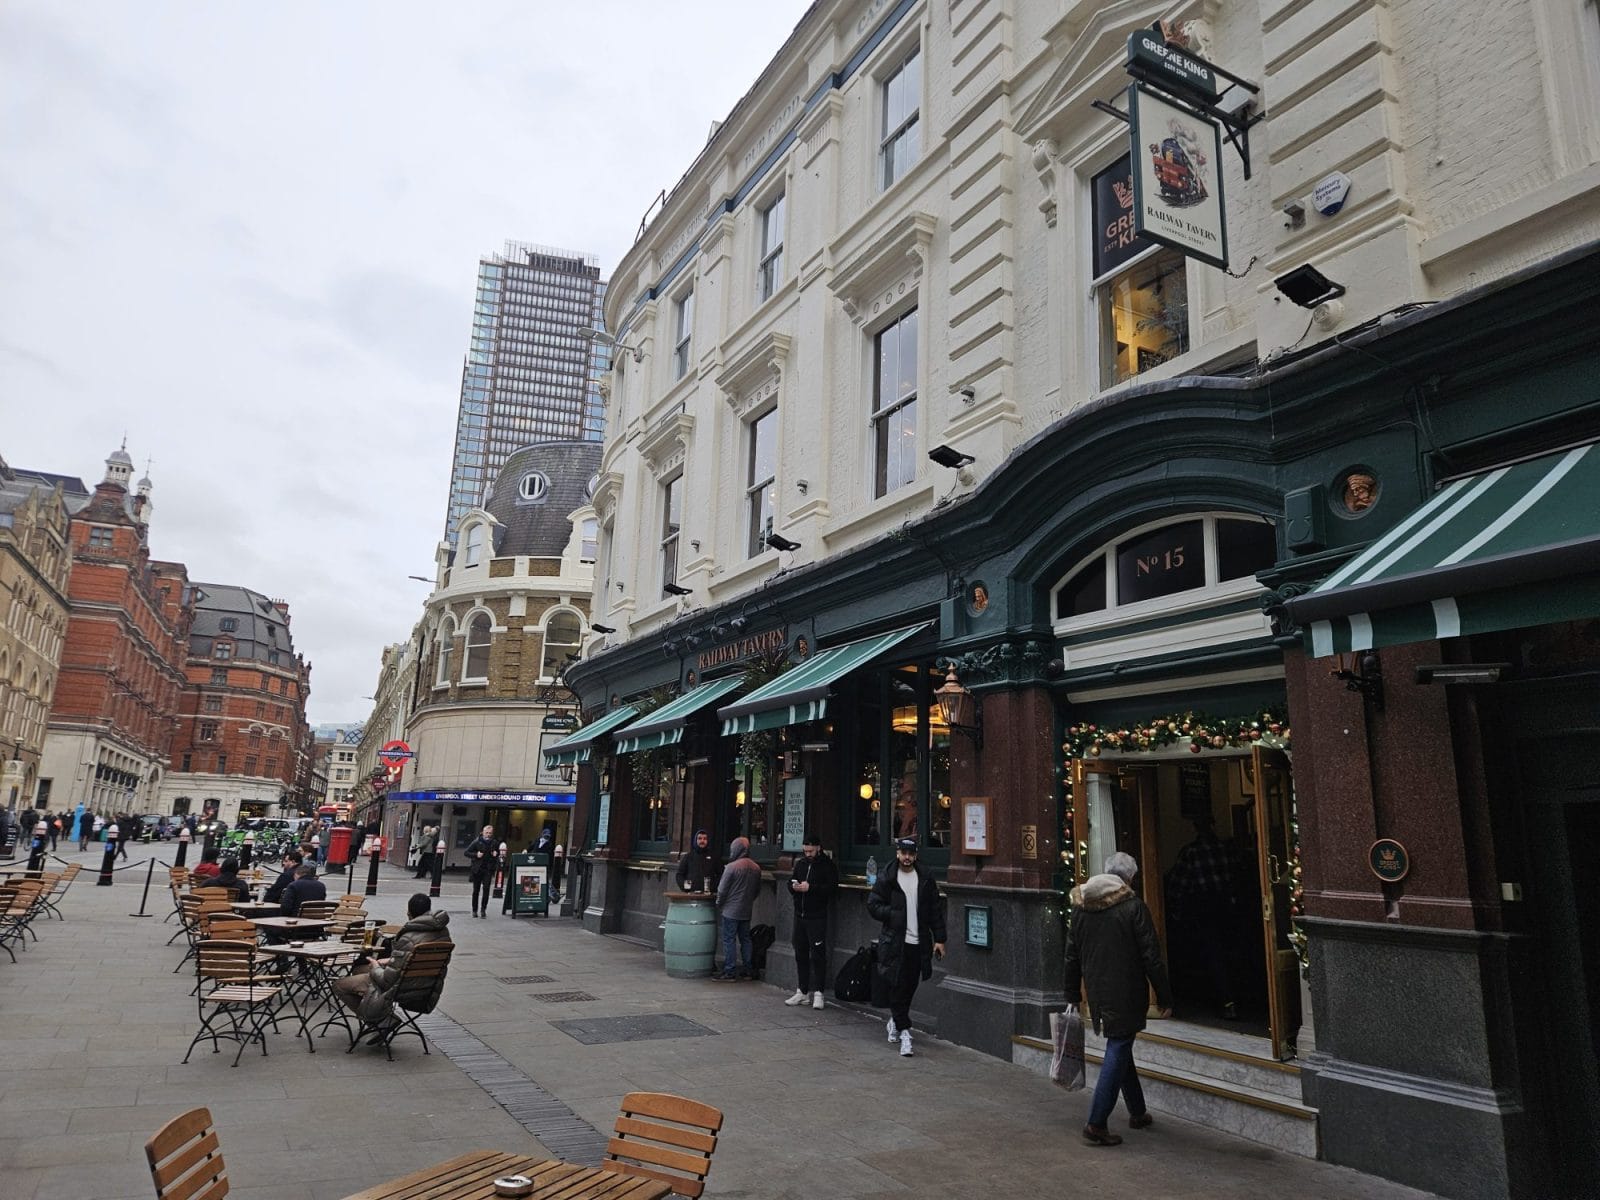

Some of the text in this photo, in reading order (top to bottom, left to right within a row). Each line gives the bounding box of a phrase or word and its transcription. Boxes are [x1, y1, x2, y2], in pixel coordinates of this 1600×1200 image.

[1142, 38, 1208, 80] GREENE KING
[1315, 185, 1341, 201] Systems
[1107, 211, 1135, 239] GRE
[1147, 206, 1217, 242] RAILWAY TAVERN
[1119, 226, 1136, 249] KI
[1165, 546, 1185, 570] 15
[699, 627, 785, 670] RAILWAY TAVERN
[522, 794, 546, 802] STATION
